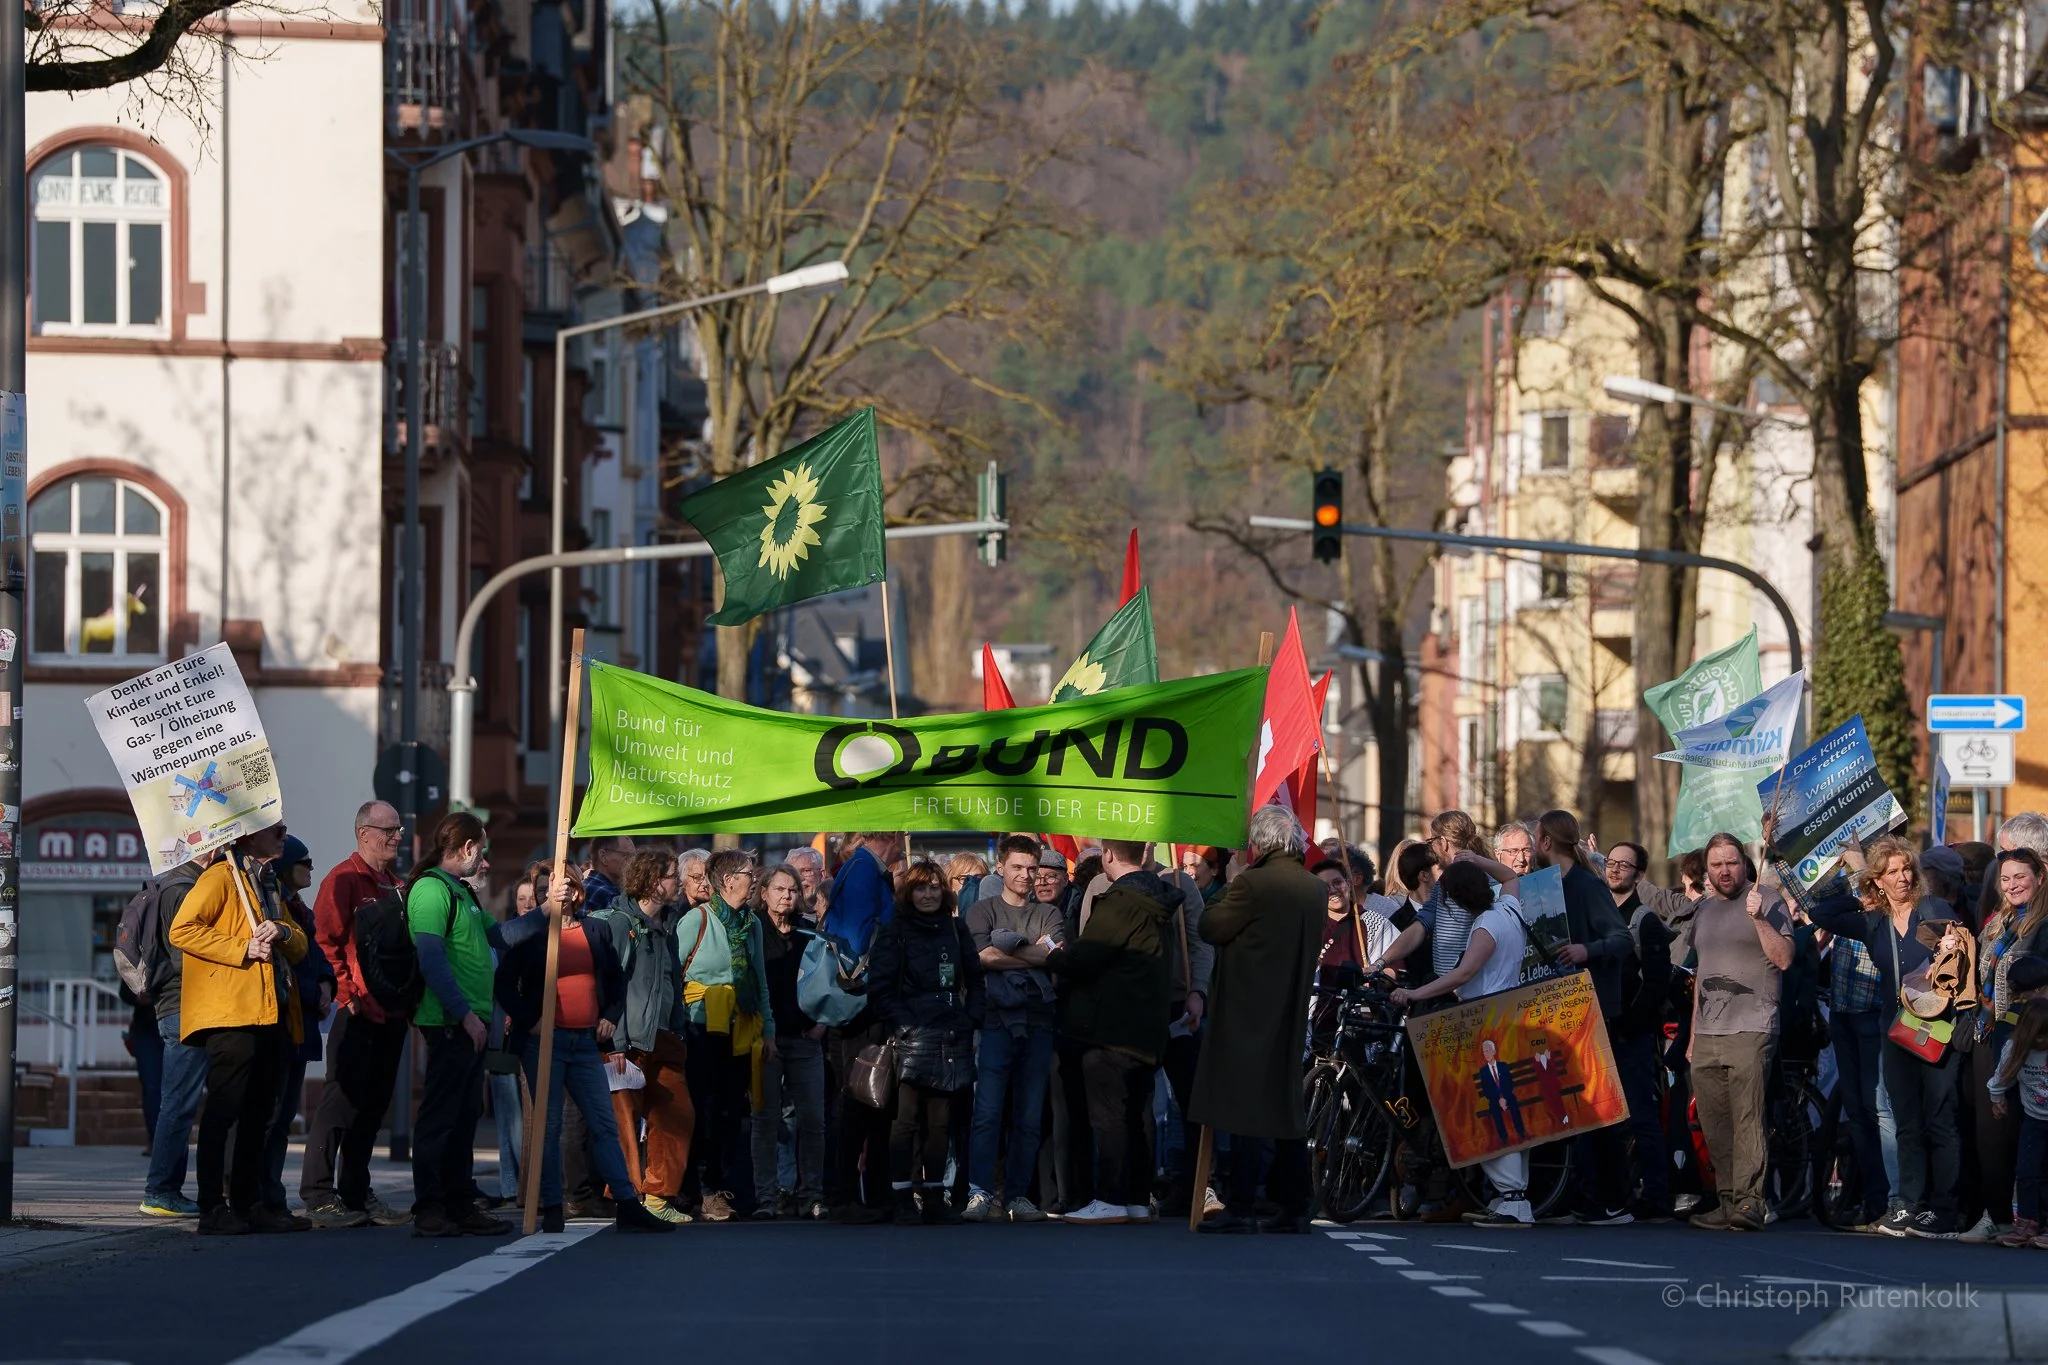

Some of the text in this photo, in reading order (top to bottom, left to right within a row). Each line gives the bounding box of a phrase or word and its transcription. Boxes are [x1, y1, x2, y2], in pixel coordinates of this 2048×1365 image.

[106, 664, 225, 719] Kinder und Enkel!
[111, 656, 206, 700] Denkt an Eure
[126, 733, 156, 748] Gas-
[169, 700, 236, 732] Ölheizung
[130, 689, 216, 728] Tauscht Eure
[617, 710, 703, 738] Bund für
[131, 730, 256, 783] Wärmepumpe aus.
[152, 723, 223, 760] gegen eine
[227, 747, 270, 766] Tipps/Beratung
[615, 735, 733, 765] Umwelt und
[923, 718, 1188, 780] BUND
[1793, 726, 1856, 775] Das Klima
[1816, 740, 1860, 772] retten.
[613, 760, 733, 788] Naturschutz
[1805, 754, 1865, 799] Weil man
[1806, 765, 1868, 815] Geld nicht
[610, 784, 731, 809] Deutschland
[913, 796, 1155, 824] FREUNDE DER ERDE
[1803, 775, 1875, 837] essen kann!
[1814, 813, 1868, 860] Klimaliste
[1422, 1004, 1486, 1028] IST DIE WELT
[1530, 1009, 1541, 1018] ES
[1545, 1003, 1558, 1014] IST
[1539, 1016, 1553, 1025] WIE
[1416, 1018, 1483, 1041] SO BESSER ZU
